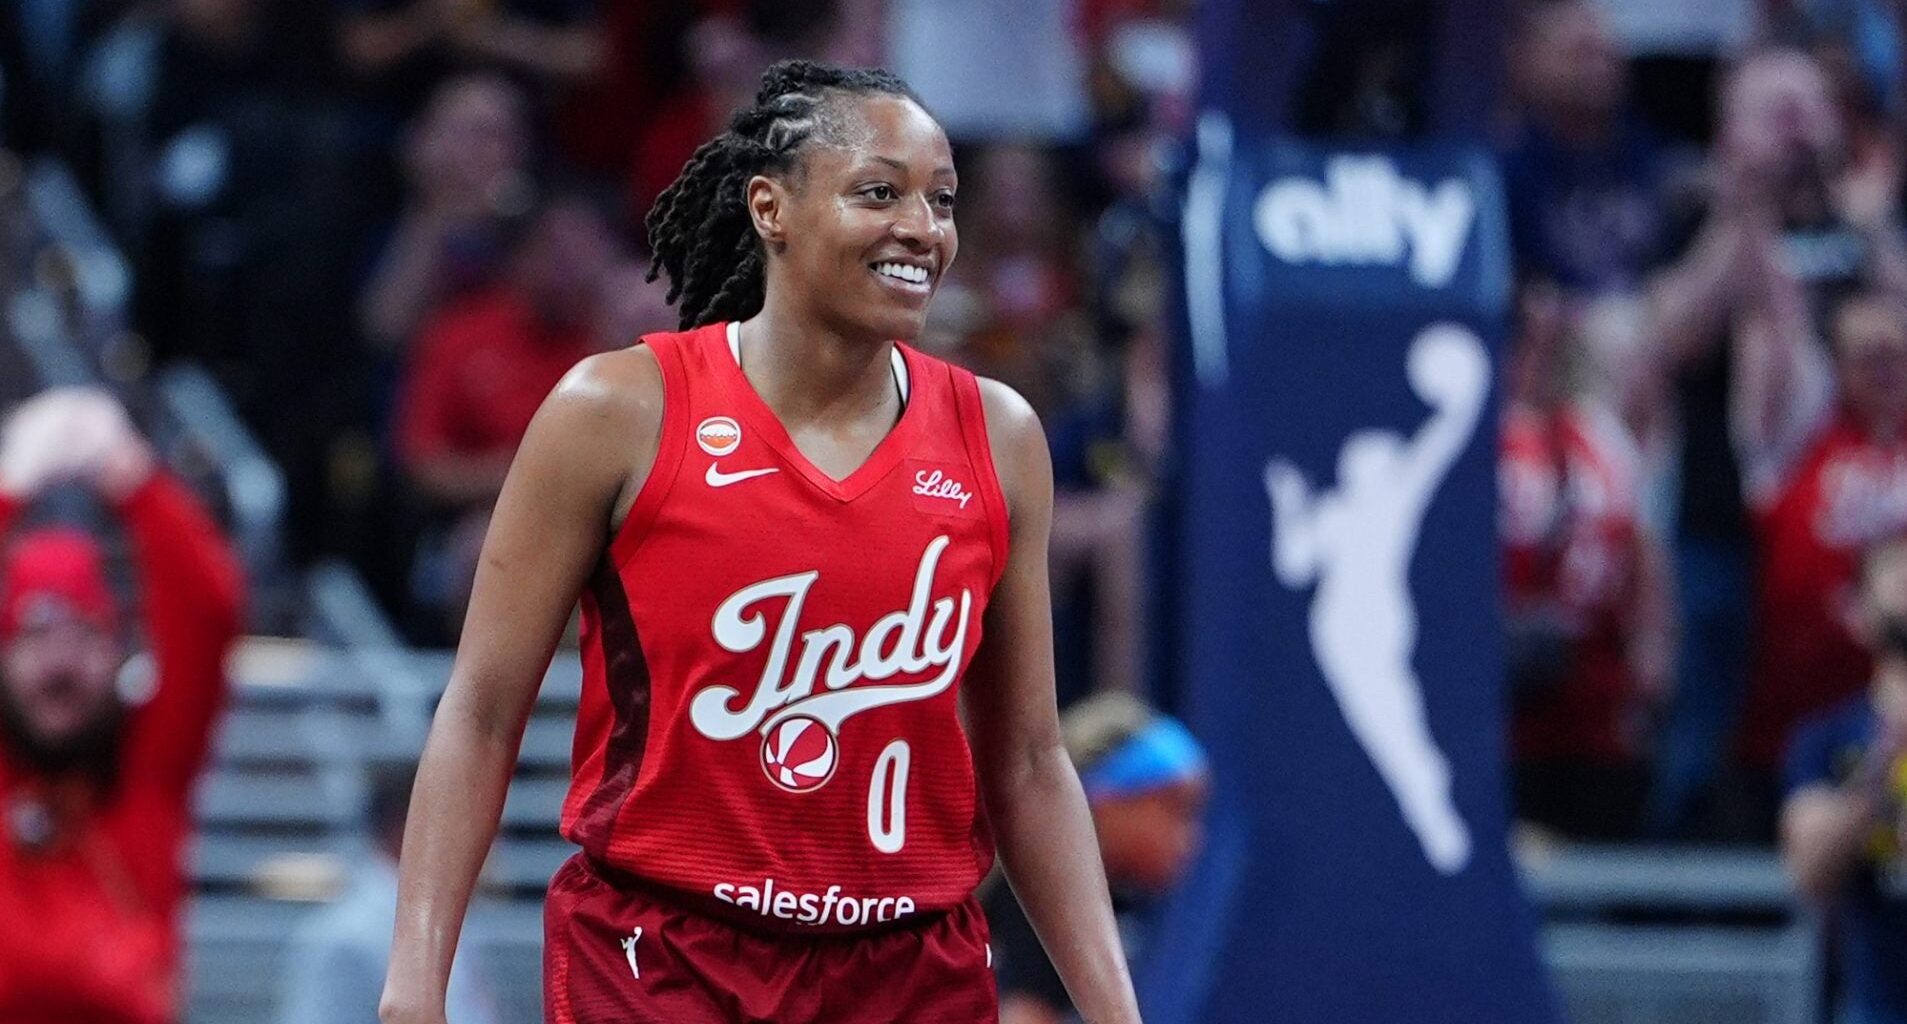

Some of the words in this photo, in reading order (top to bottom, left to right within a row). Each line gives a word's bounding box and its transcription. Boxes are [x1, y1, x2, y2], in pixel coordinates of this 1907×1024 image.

[1253, 153, 1475, 287] ally
[912, 470, 972, 509] Lilly
[690, 535, 971, 741] Indy
[867, 739, 911, 854] 0
[713, 878, 915, 925] salesforce
